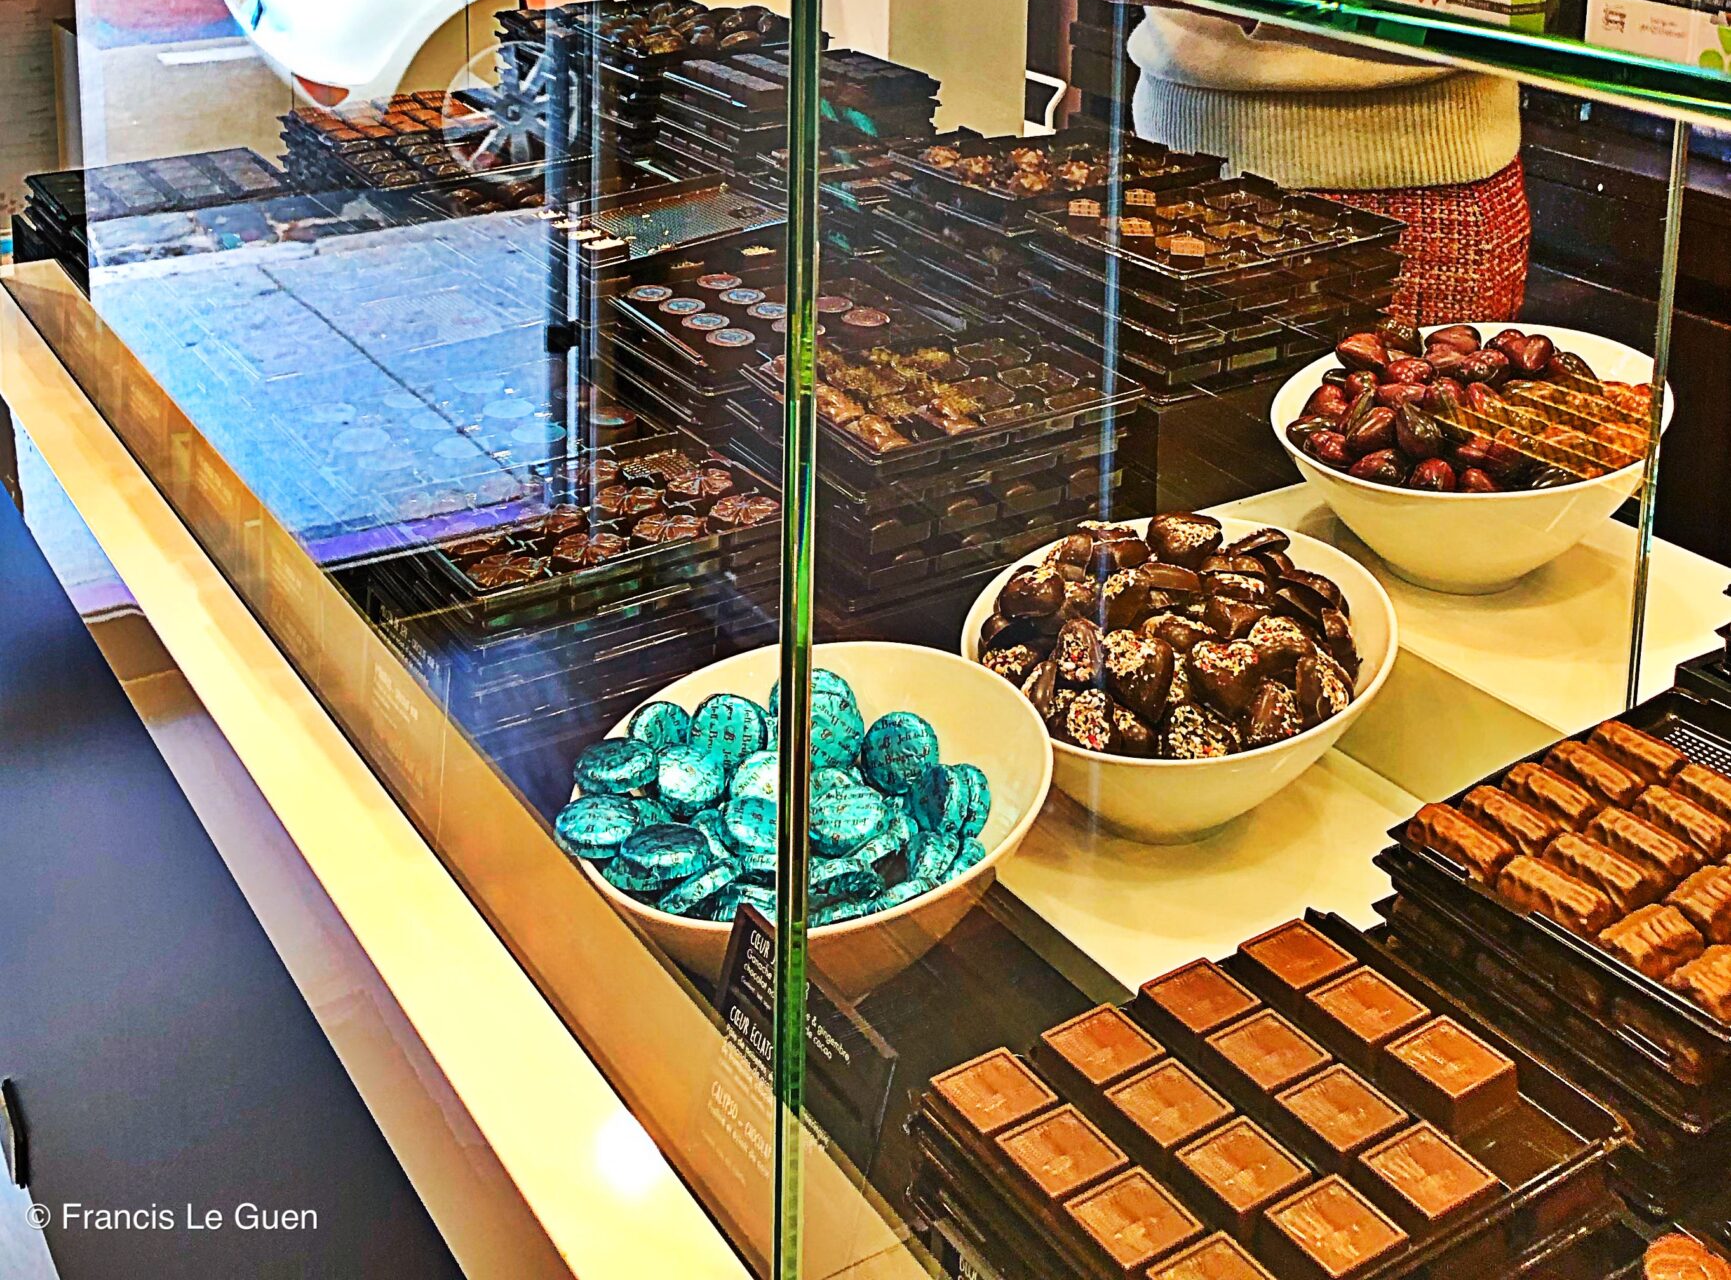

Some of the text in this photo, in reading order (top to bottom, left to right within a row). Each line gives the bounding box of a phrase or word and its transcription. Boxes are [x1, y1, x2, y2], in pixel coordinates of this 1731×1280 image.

[750, 929, 770, 958] CŒUR
[730, 1005, 774, 1061] CŒUR ÉCLATS
